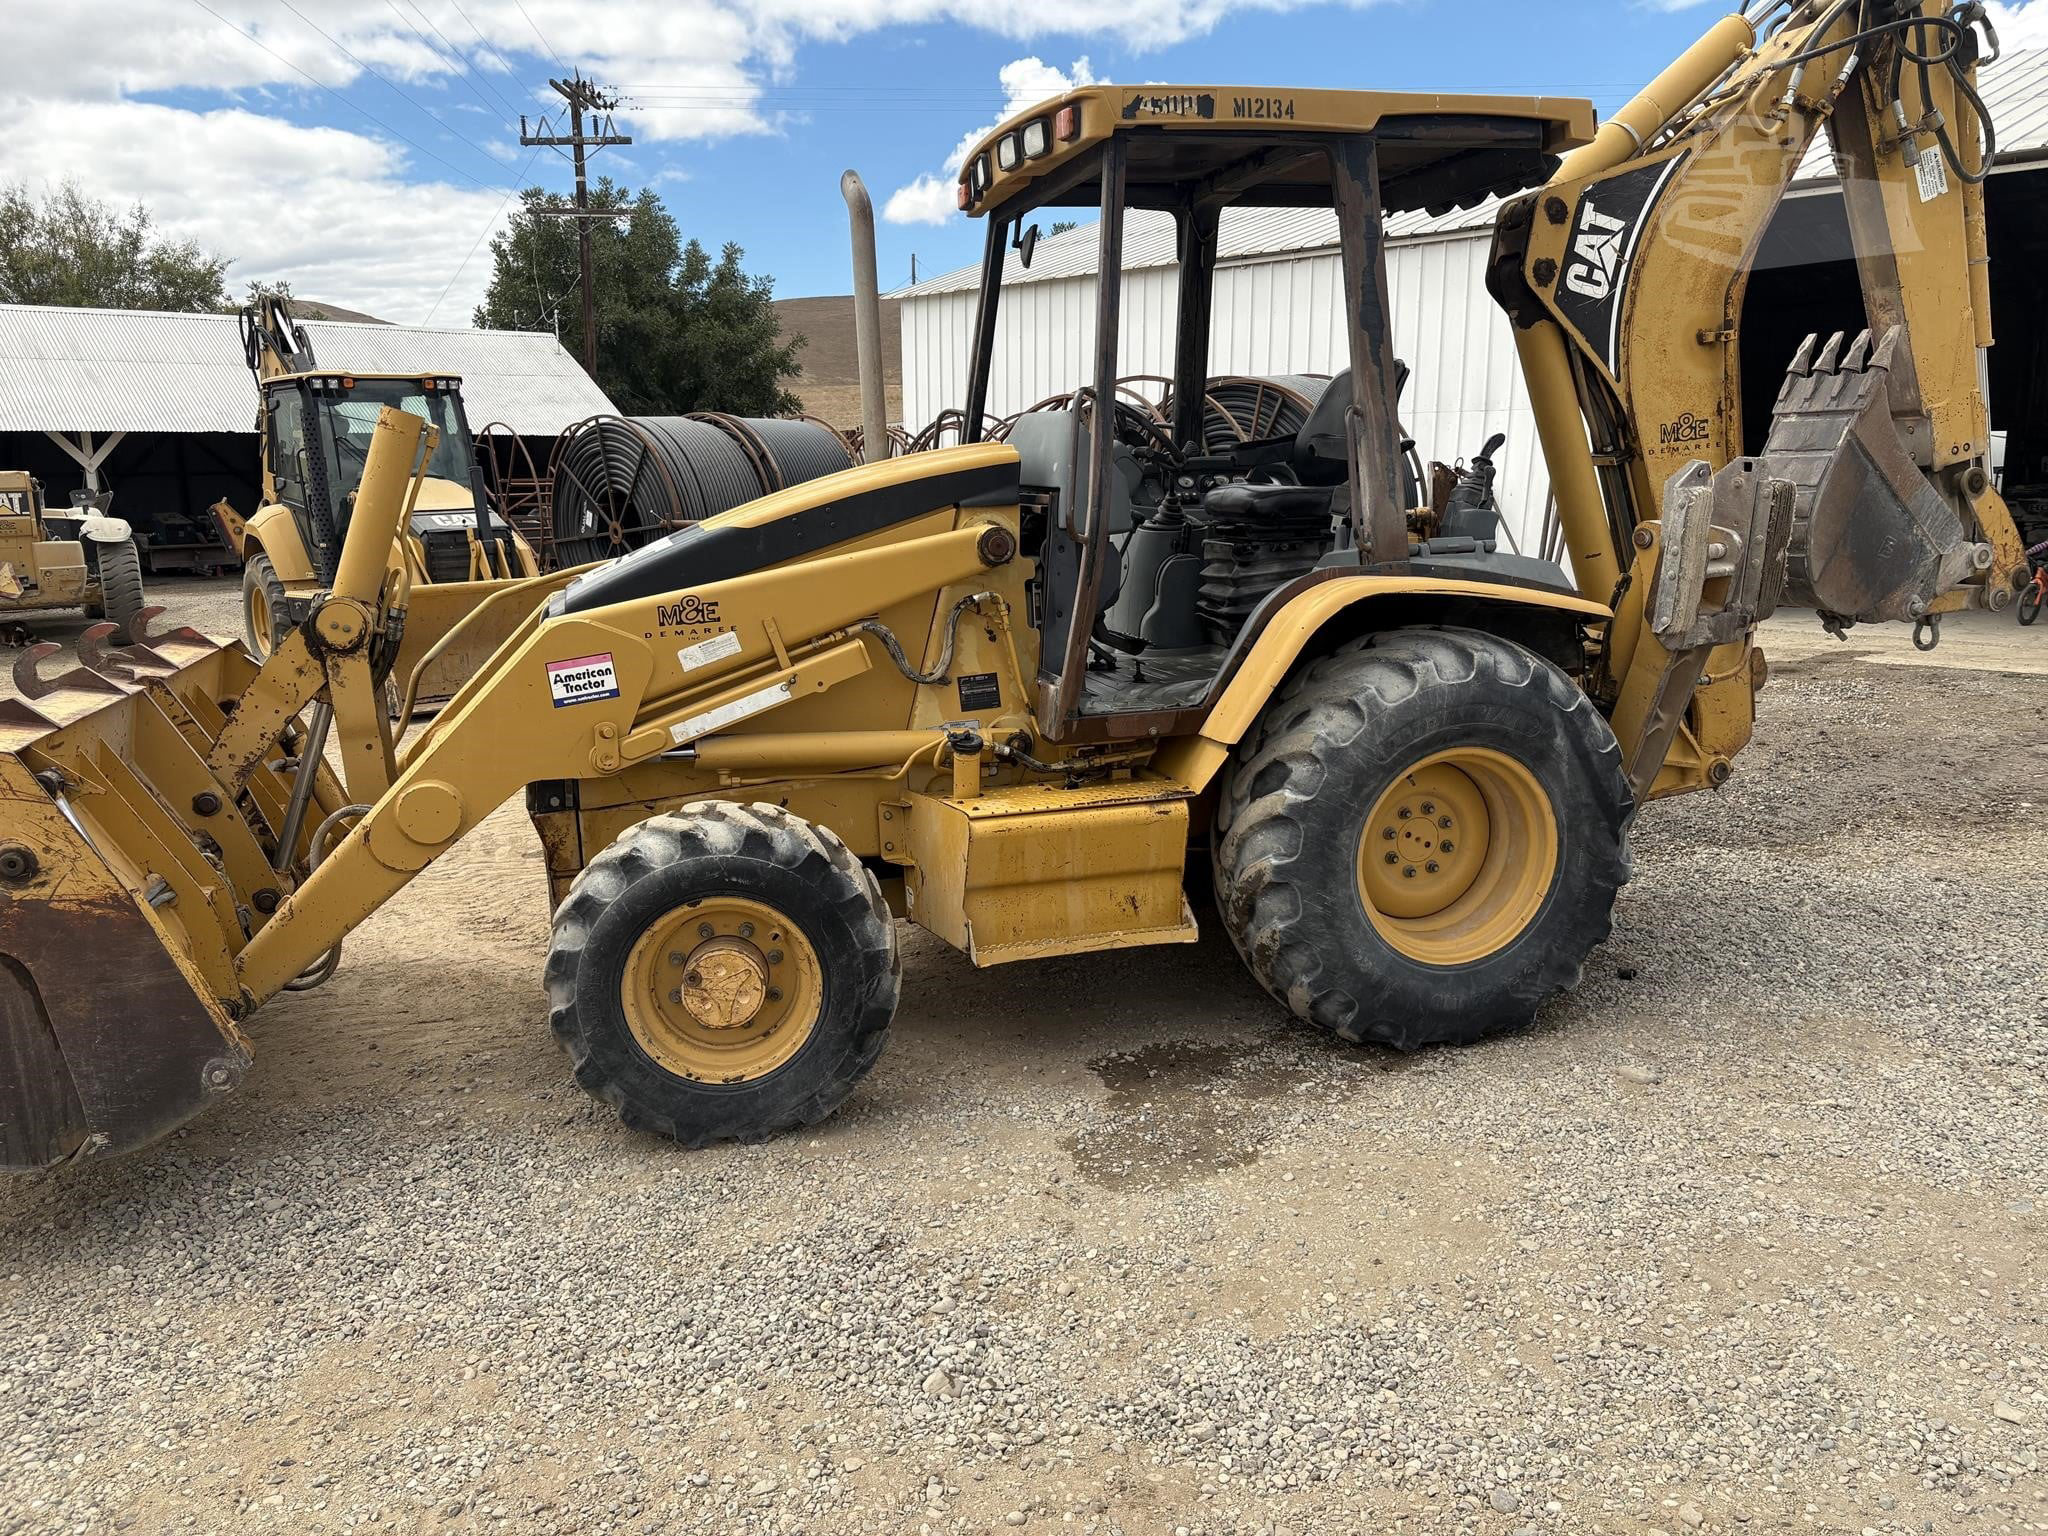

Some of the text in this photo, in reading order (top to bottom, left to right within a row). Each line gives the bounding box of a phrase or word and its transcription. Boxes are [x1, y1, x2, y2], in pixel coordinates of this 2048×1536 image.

[1233, 98, 1295, 120] M12134
[1566, 199, 1626, 299] CAT
[1660, 413, 1709, 443] M&E
[1648, 441, 1721, 455] DEMAREE
[0, 492, 22, 515] AT
[657, 594, 721, 627] M&E
[644, 625, 738, 639] DEMAREE
[553, 667, 612, 685] American
[563, 679, 605, 694] Tractor
